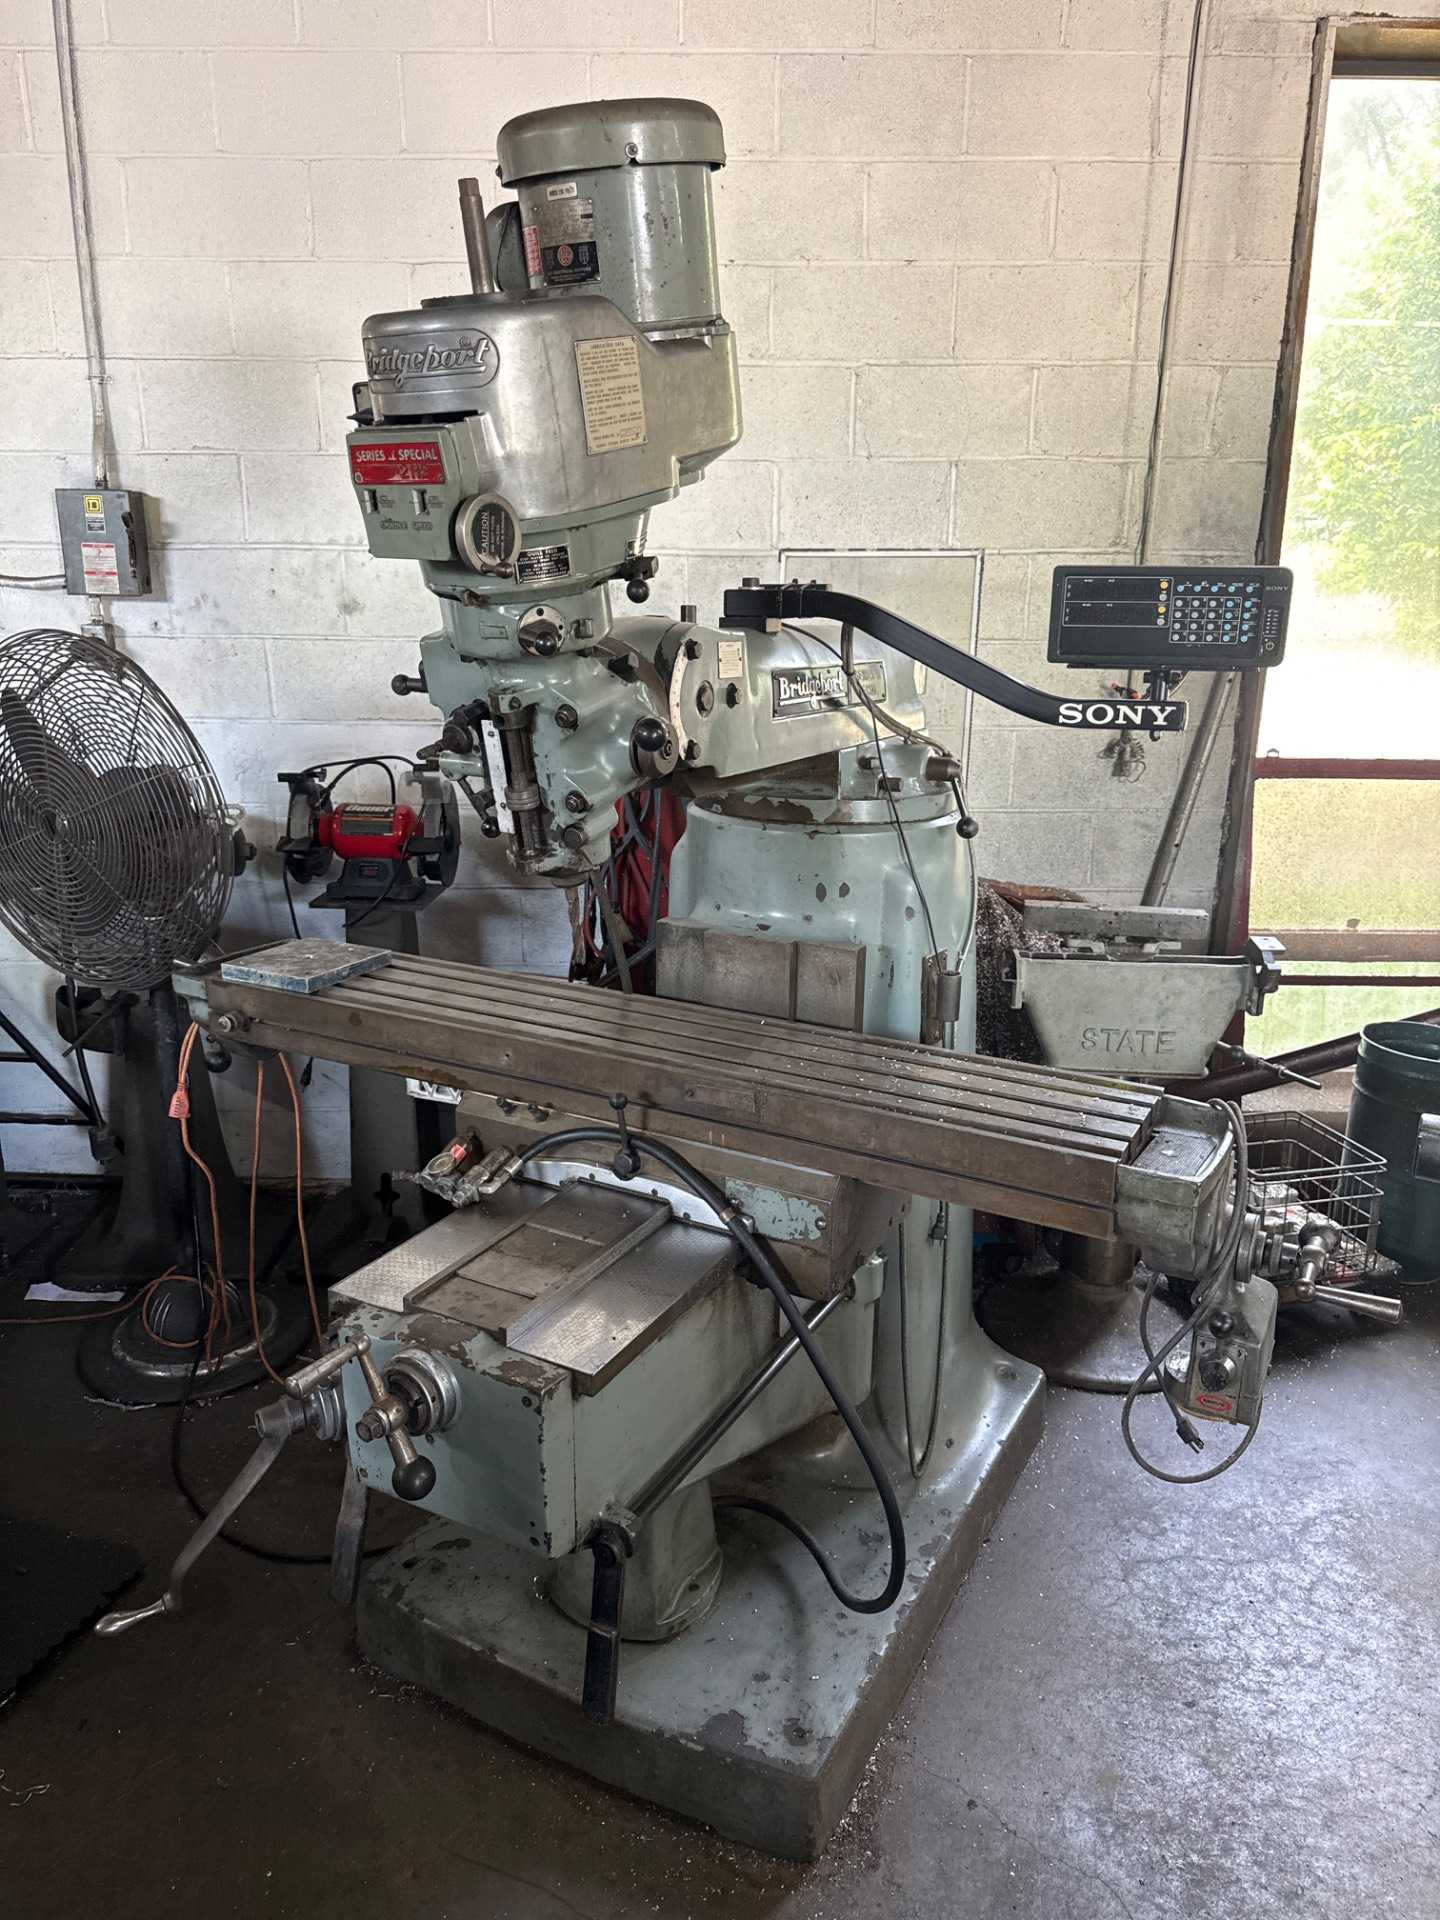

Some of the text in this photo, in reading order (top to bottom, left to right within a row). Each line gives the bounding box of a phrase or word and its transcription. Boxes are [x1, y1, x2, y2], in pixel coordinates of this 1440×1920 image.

[355, 449, 386, 463] SERIES
[398, 448, 438, 461] SPECIAL
[481, 512, 490, 556] CAUTION
[778, 671, 845, 710] Bridgeport
[1058, 702, 1176, 725] SONY
[1081, 1027, 1177, 1054] STATE
